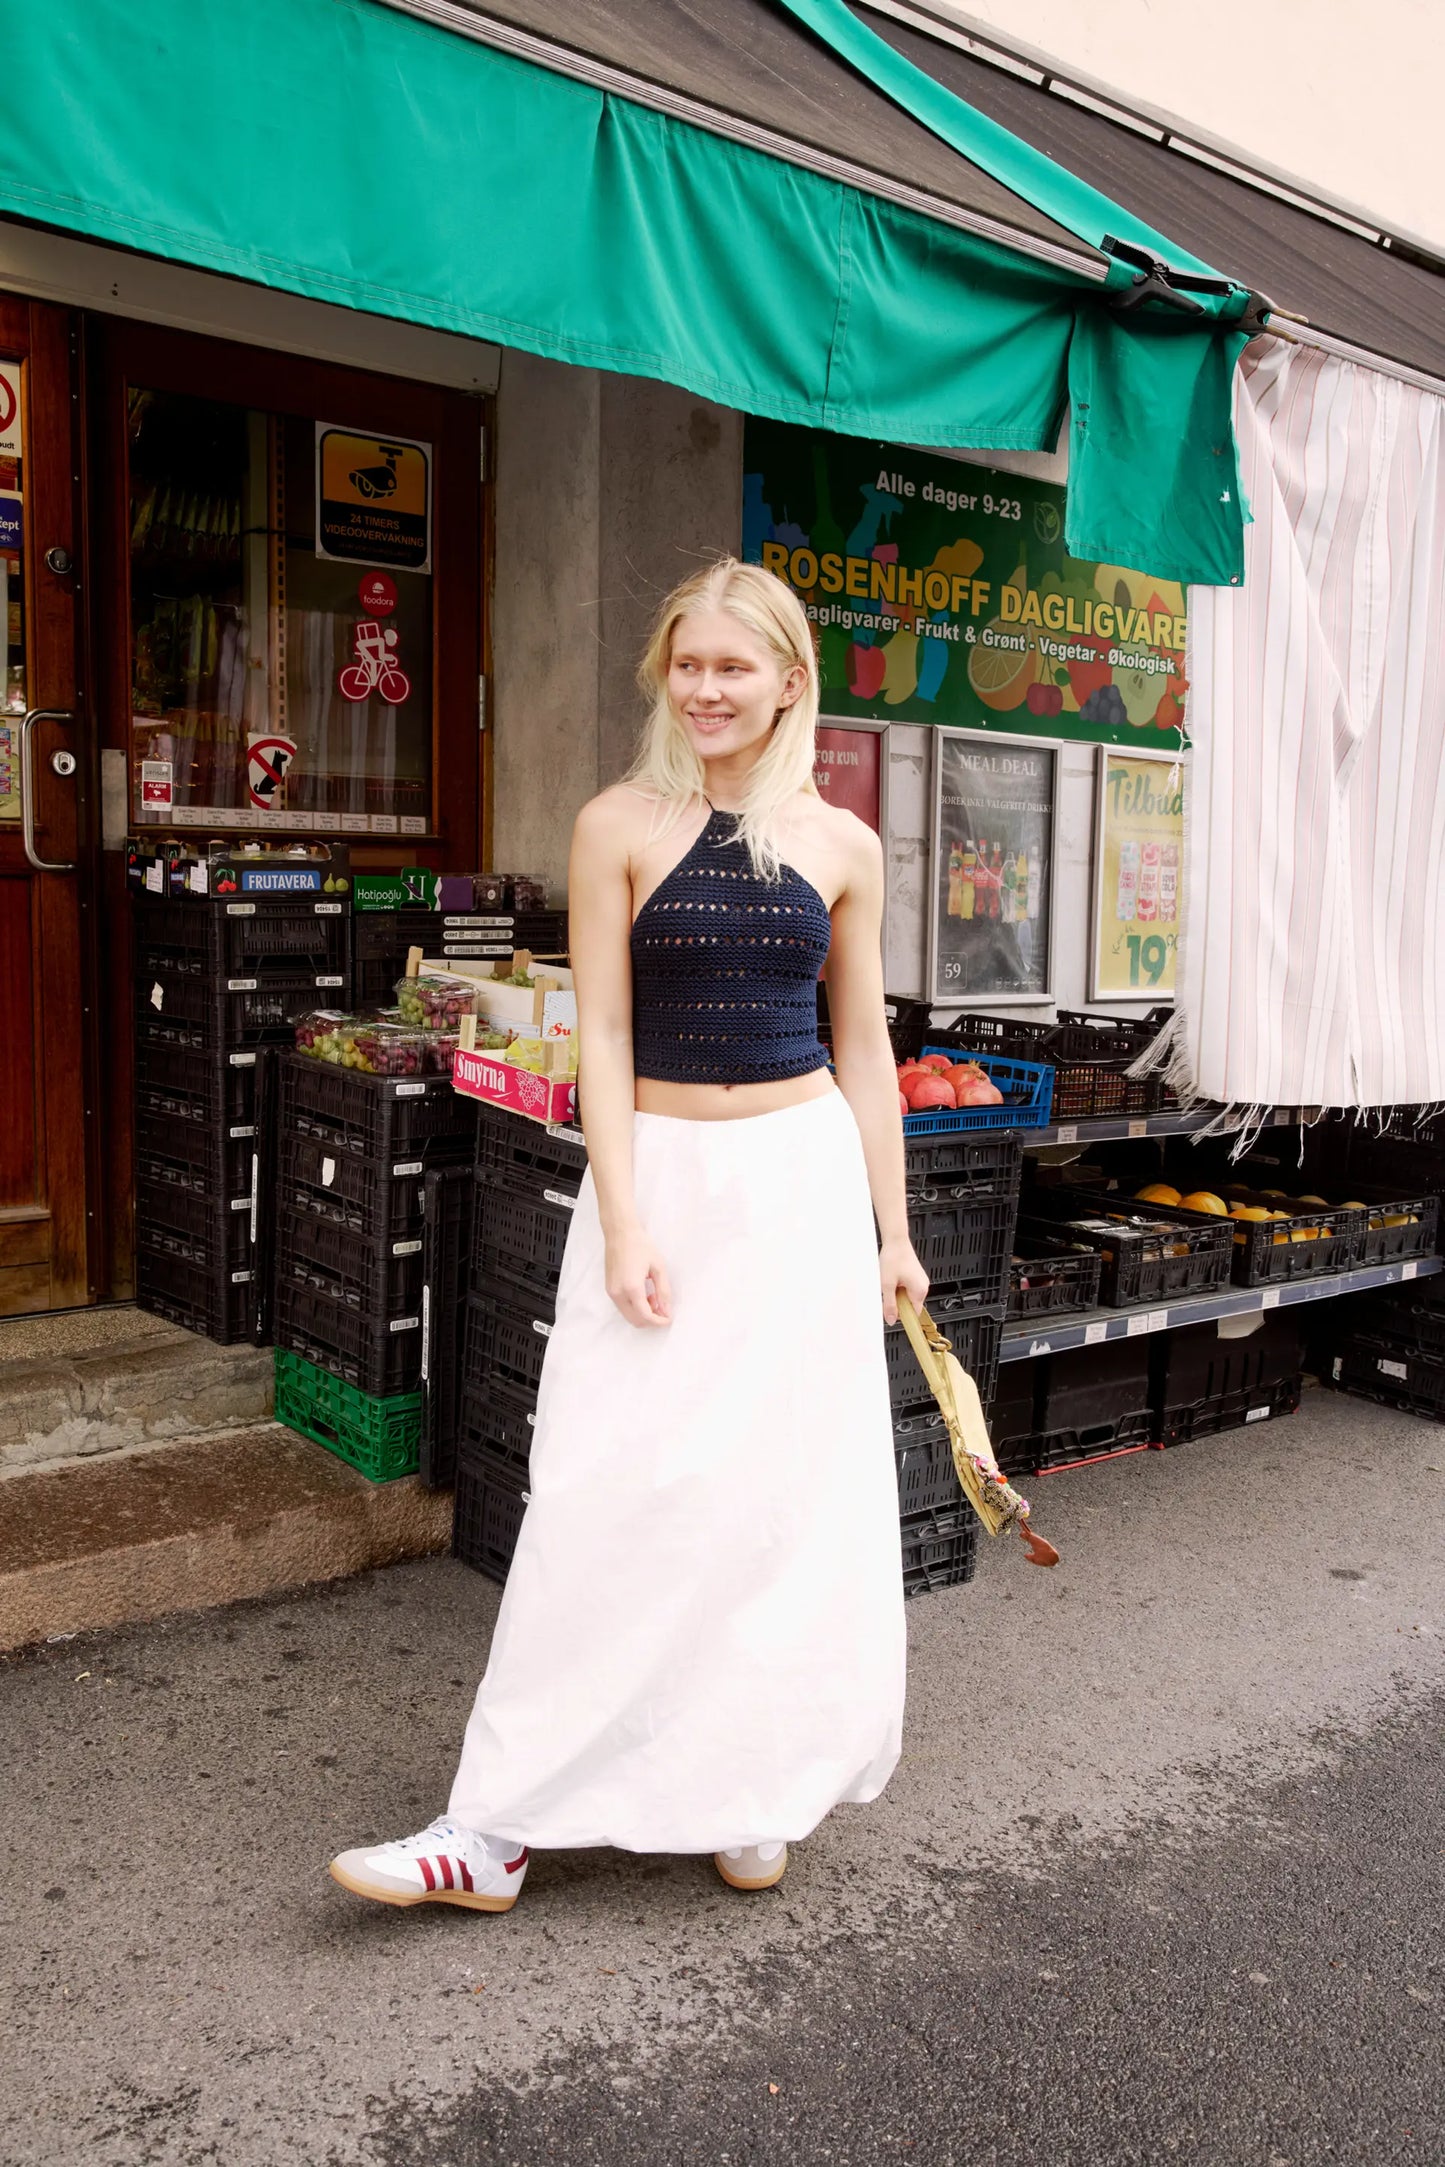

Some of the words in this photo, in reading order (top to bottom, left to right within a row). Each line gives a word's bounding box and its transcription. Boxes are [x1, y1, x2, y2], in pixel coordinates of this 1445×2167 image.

[876, 470, 916, 497] Alle
[922, 482, 978, 512] dager
[983, 494, 1022, 521] 9-23
[349, 512, 361, 524] 24
[364, 515, 400, 530] TIMERS
[363, 594, 394, 606] foodora
[762, 541, 991, 616] ROSENHOFF
[1000, 585, 1188, 651] DAGLIGVARE
[916, 617, 960, 642] Frukt
[965, 625, 977, 644] &
[982, 627, 1026, 652] Grønt
[1039, 637, 1096, 662] Vegetar
[1108, 647, 1176, 675] Økologisk
[815, 749, 835, 765] FOR
[837, 751, 859, 766] KUN
[960, 754, 999, 773] MEAL
[1002, 758, 1038, 777] DEAL
[987, 799, 1026, 812] VALGFRITT
[248, 873, 316, 889] FRUTAVERA
[357, 888, 402, 903] Hatipoğlu
[1127, 934, 1167, 987] 19
[945, 962, 962, 979] 59
[456, 1053, 506, 1093] Smyrna
